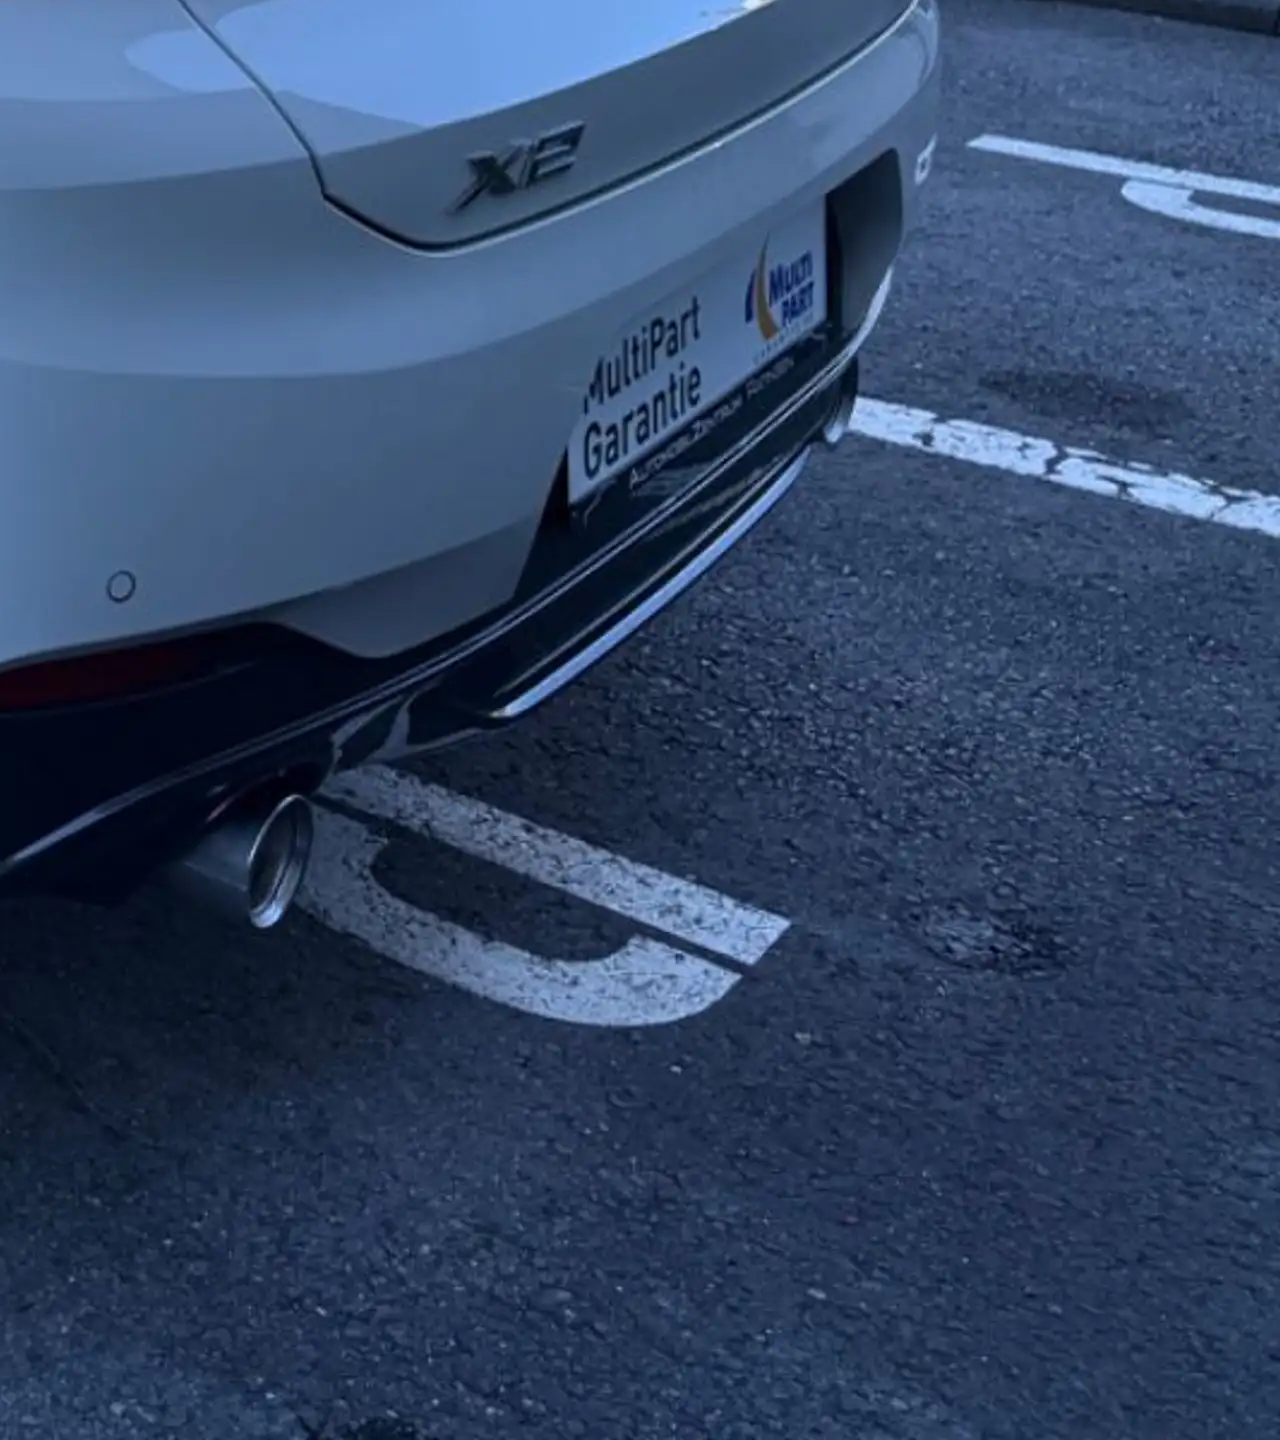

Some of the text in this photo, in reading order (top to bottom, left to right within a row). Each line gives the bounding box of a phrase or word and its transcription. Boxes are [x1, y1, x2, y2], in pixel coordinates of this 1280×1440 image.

[445, 120, 587, 216] X2
[583, 295, 702, 416] MultiPart
[583, 361, 702, 480] Garantie
